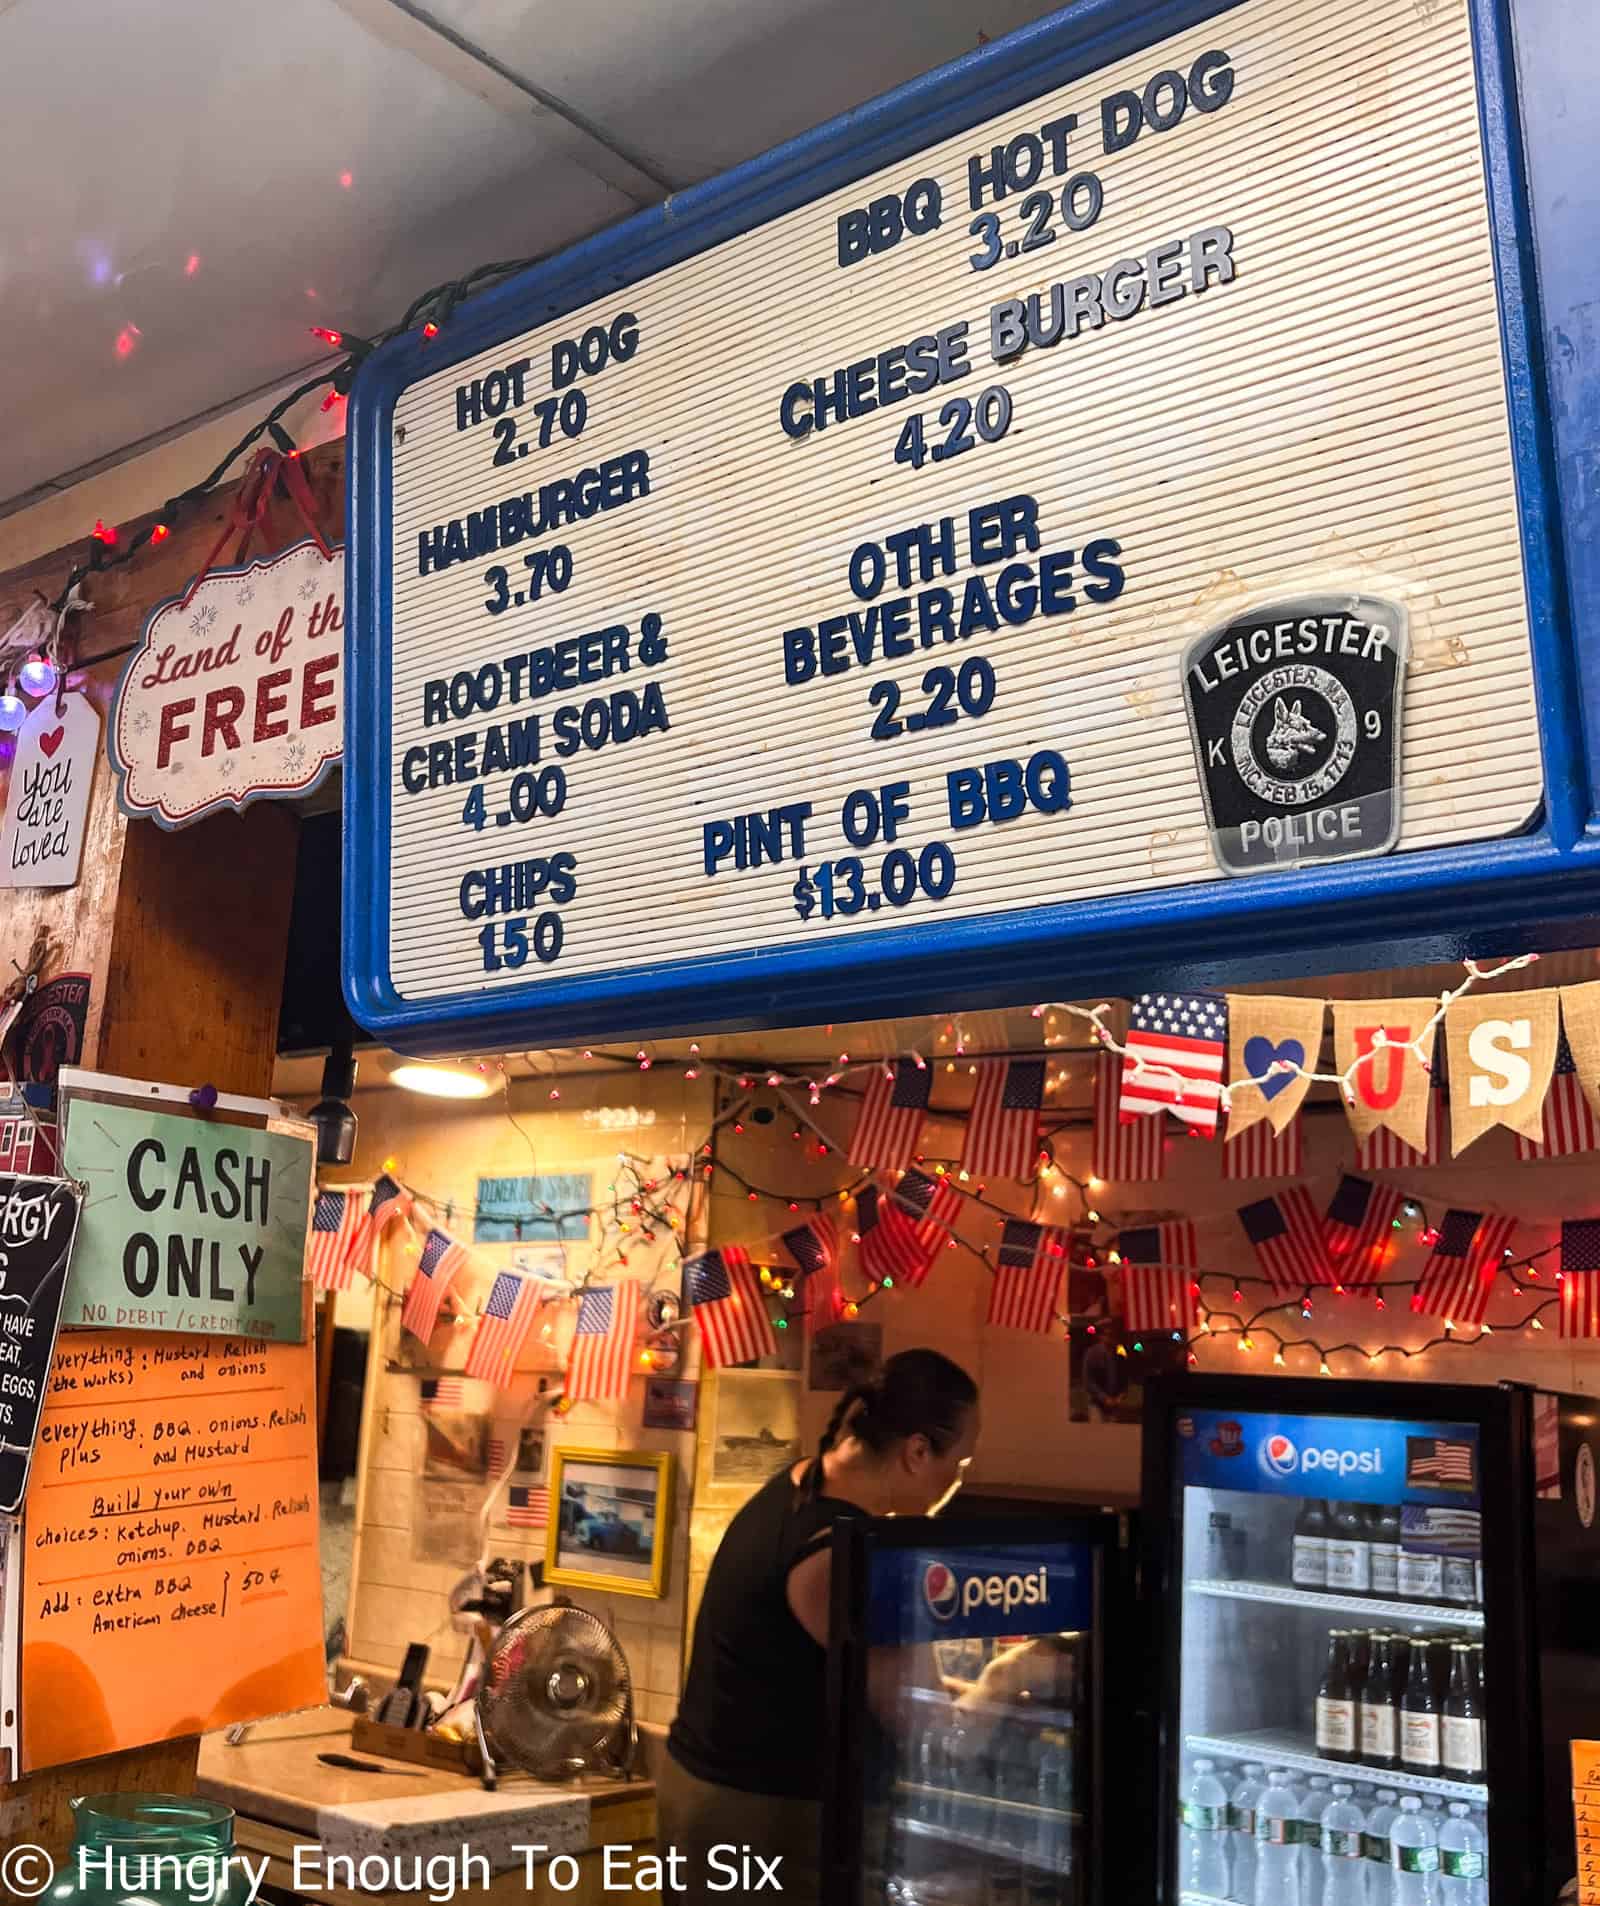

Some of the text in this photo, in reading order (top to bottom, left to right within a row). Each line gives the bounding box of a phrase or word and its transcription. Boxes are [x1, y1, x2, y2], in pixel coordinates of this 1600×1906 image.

[837, 49, 1235, 268] BBQ HOT DOG
[968, 171, 1104, 271] 3.20
[779, 225, 1236, 438] CHEESE BURGER
[455, 312, 640, 431] HOT DOG
[492, 389, 587, 467] 2.70
[894, 384, 1012, 470] 4.20
[418, 449, 651, 576] HAMBURGER
[484, 545, 573, 615] 3.70
[782, 538, 1126, 686] BEVERAGES
[142, 593, 345, 689] Land of th
[423, 612, 669, 727] ROOTBEER &
[1191, 618, 1390, 693] LEICESTER
[156, 653, 340, 769] FREE
[868, 656, 996, 739] 2.20
[402, 681, 672, 794] CREAM SODA
[1207, 710, 1382, 768] K 9
[17, 758, 72, 820] you
[28, 797, 63, 827] are
[462, 765, 567, 831] 4.00
[703, 749, 1073, 876] PINT OF BBQ
[12, 821, 69, 869] loved
[1240, 806, 1362, 852] POLICE
[459, 852, 577, 920] CHIPS
[793, 841, 956, 921] $13.00
[127, 1138, 271, 1226] CASH
[123, 1232, 264, 1305] ONLY
[3, 1313, 35, 1337] HAVE
[82, 1304, 106, 1322] NO
[117, 1307, 167, 1327] DEBIT
[224, 1339, 267, 1358] Relish
[2, 1373, 36, 1402] EGGS,
[181, 1365, 204, 1380] and
[218, 1362, 266, 1377] onions
[153, 1449, 176, 1465] and
[186, 1436, 250, 1463] Mustard
[269, 1405, 306, 1429] Relish
[1301, 1448, 1381, 1477] pepsi
[92, 1486, 141, 1516] Build
[199, 1480, 232, 1498] own
[186, 1538, 222, 1556] BBQ
[93, 1585, 142, 1606] extra
[155, 1576, 192, 1595] BBQ
[93, 1614, 160, 1633] American
[963, 1566, 1048, 1616] pepsi
